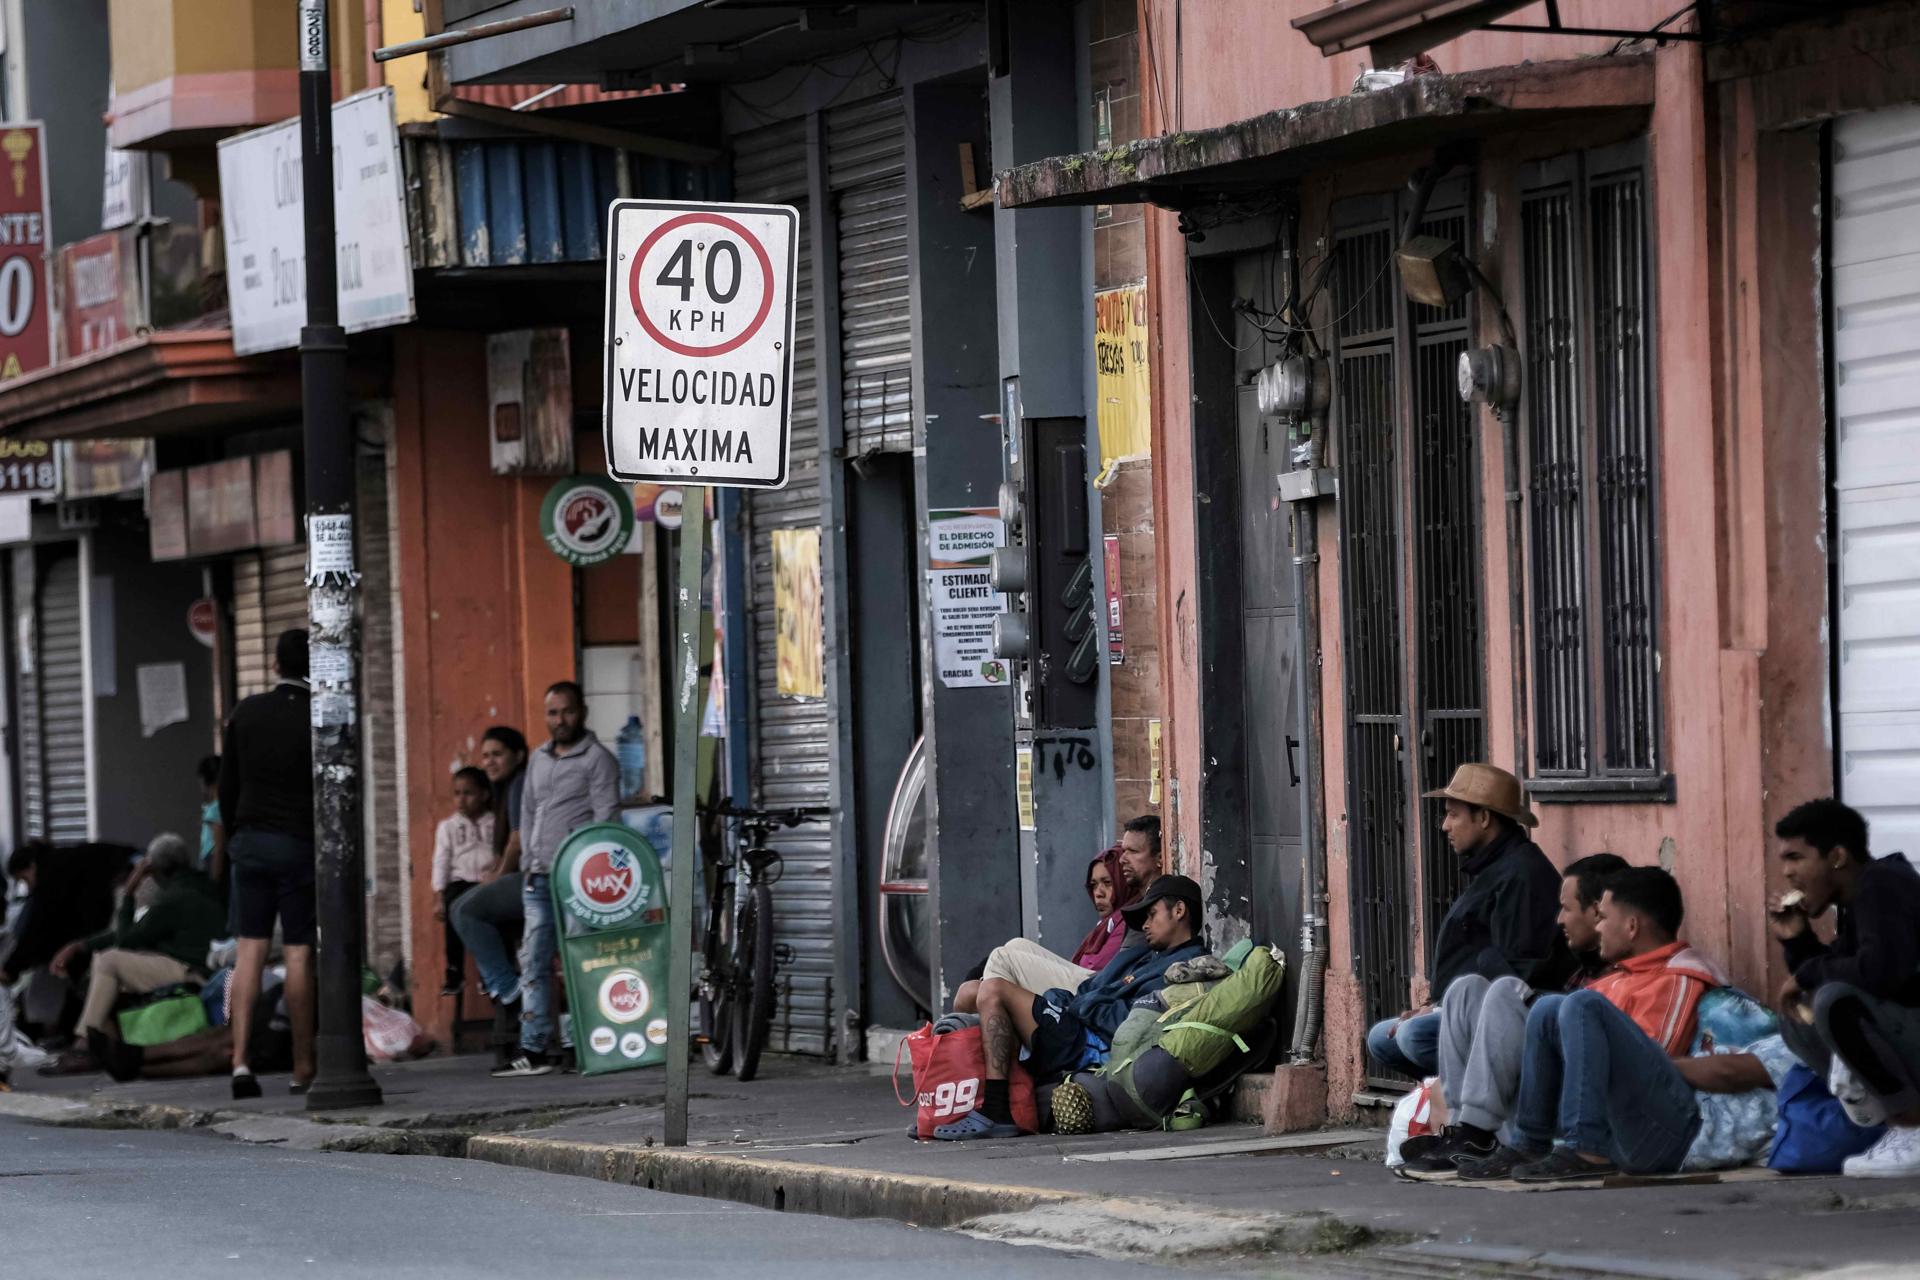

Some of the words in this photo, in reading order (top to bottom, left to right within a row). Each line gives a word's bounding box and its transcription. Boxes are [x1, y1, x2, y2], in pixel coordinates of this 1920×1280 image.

[656, 239, 742, 304] 40
[669, 309, 725, 332] KPH
[619, 367, 776, 407] VELOCIDAD
[639, 426, 753, 463] MAXIMA
[939, 533, 949, 541] EL
[951, 531, 994, 541] DERECHO
[939, 543, 950, 551] DE
[952, 540, 995, 550] ADMISIÓN
[949, 587, 988, 600] CLIENTE
[942, 669, 973, 678] GRACIAS
[1034, 737, 1095, 787] TITO
[586, 872, 628, 896] MAX
